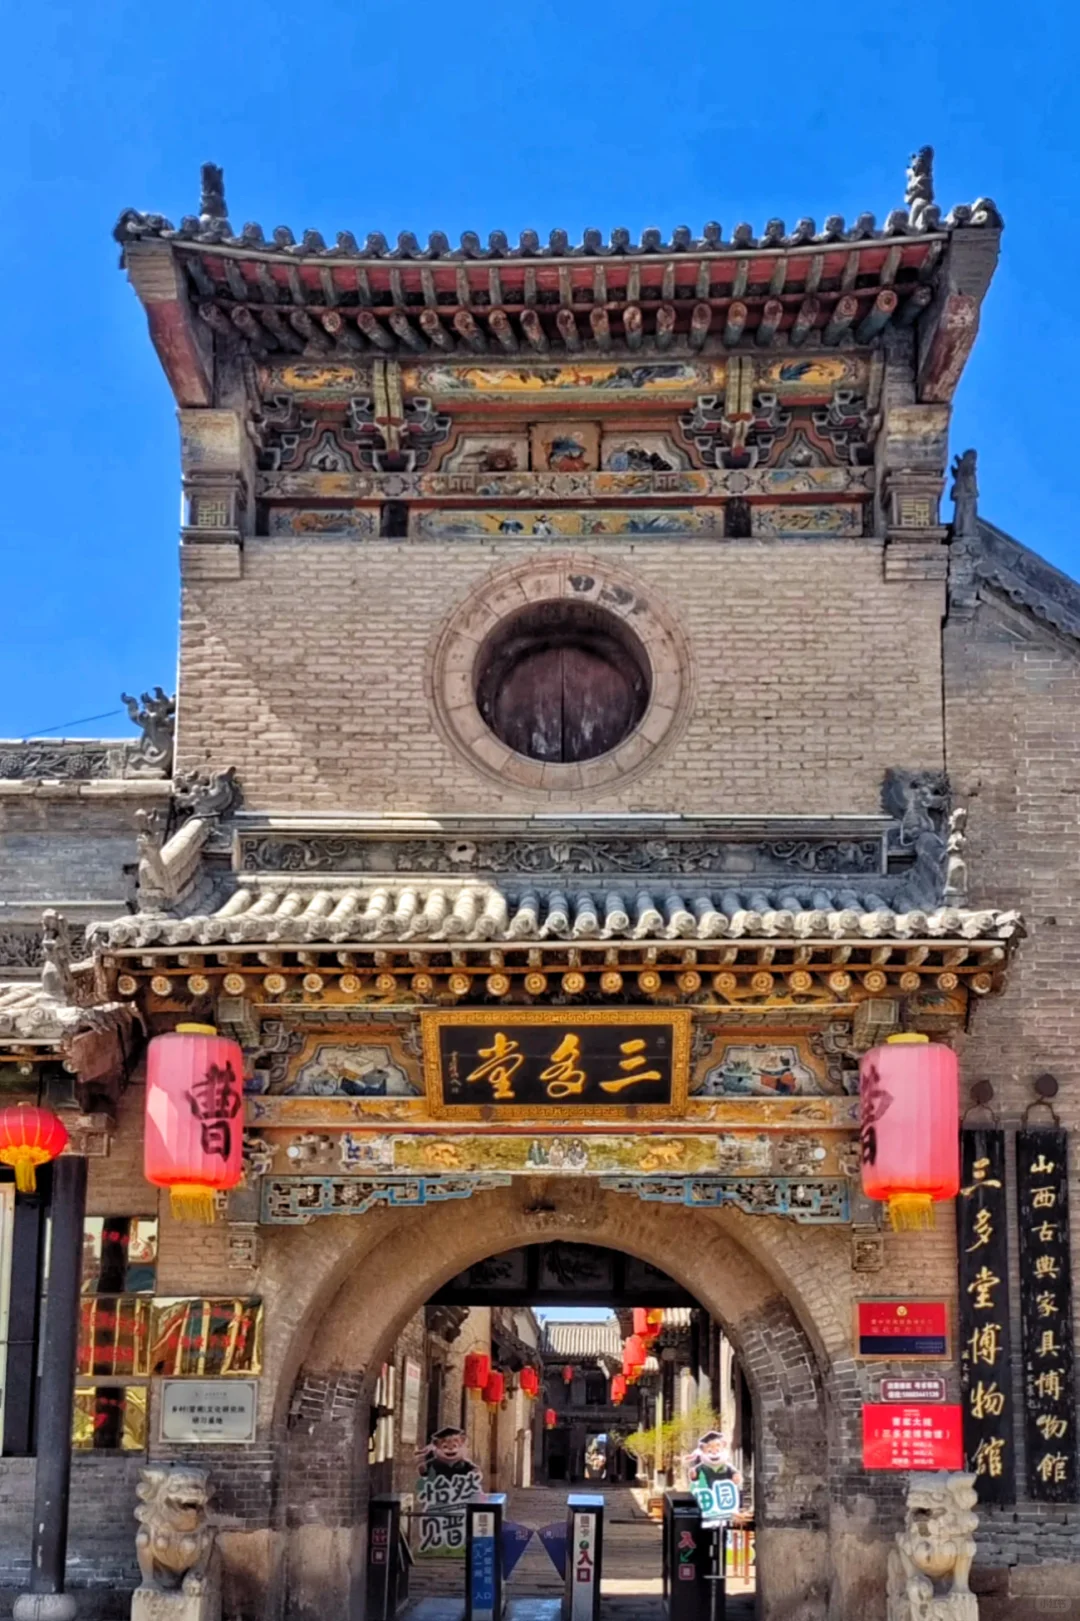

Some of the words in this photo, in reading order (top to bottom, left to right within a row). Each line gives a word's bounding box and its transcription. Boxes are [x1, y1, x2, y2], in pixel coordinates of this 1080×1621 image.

[960, 1157, 1005, 1477] 三多堂博物館
[420, 1473, 480, 1503] 怡然
[577, 1550, 593, 1582] 入口
